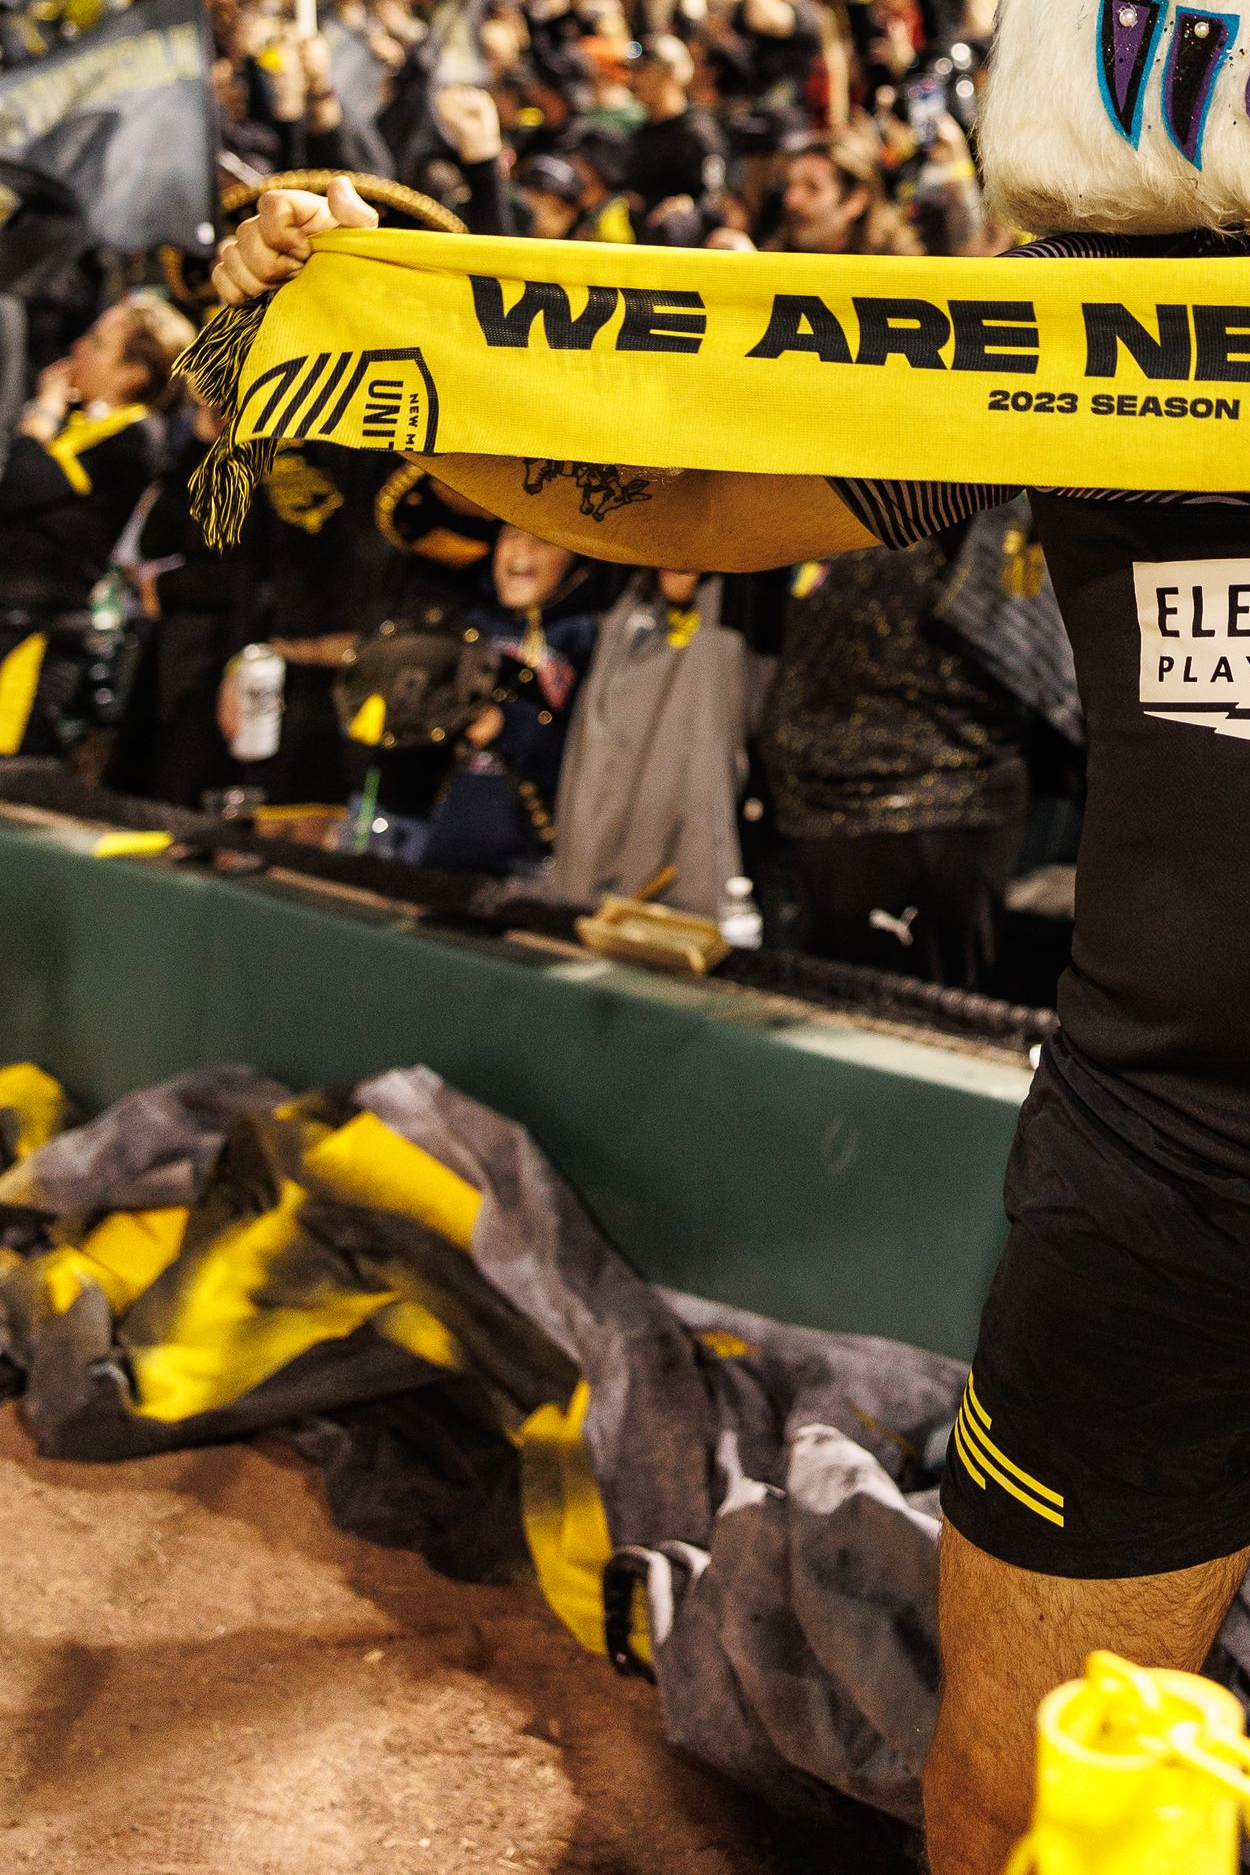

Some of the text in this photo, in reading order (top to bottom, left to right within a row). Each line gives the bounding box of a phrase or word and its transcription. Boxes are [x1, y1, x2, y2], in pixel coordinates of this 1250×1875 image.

[468, 274, 708, 354] WE
[745, 293, 1040, 372] ARE
[409, 393, 420, 428] NEW
[987, 388, 1079, 415] 2023
[1090, 392, 1241, 421] SEASON
